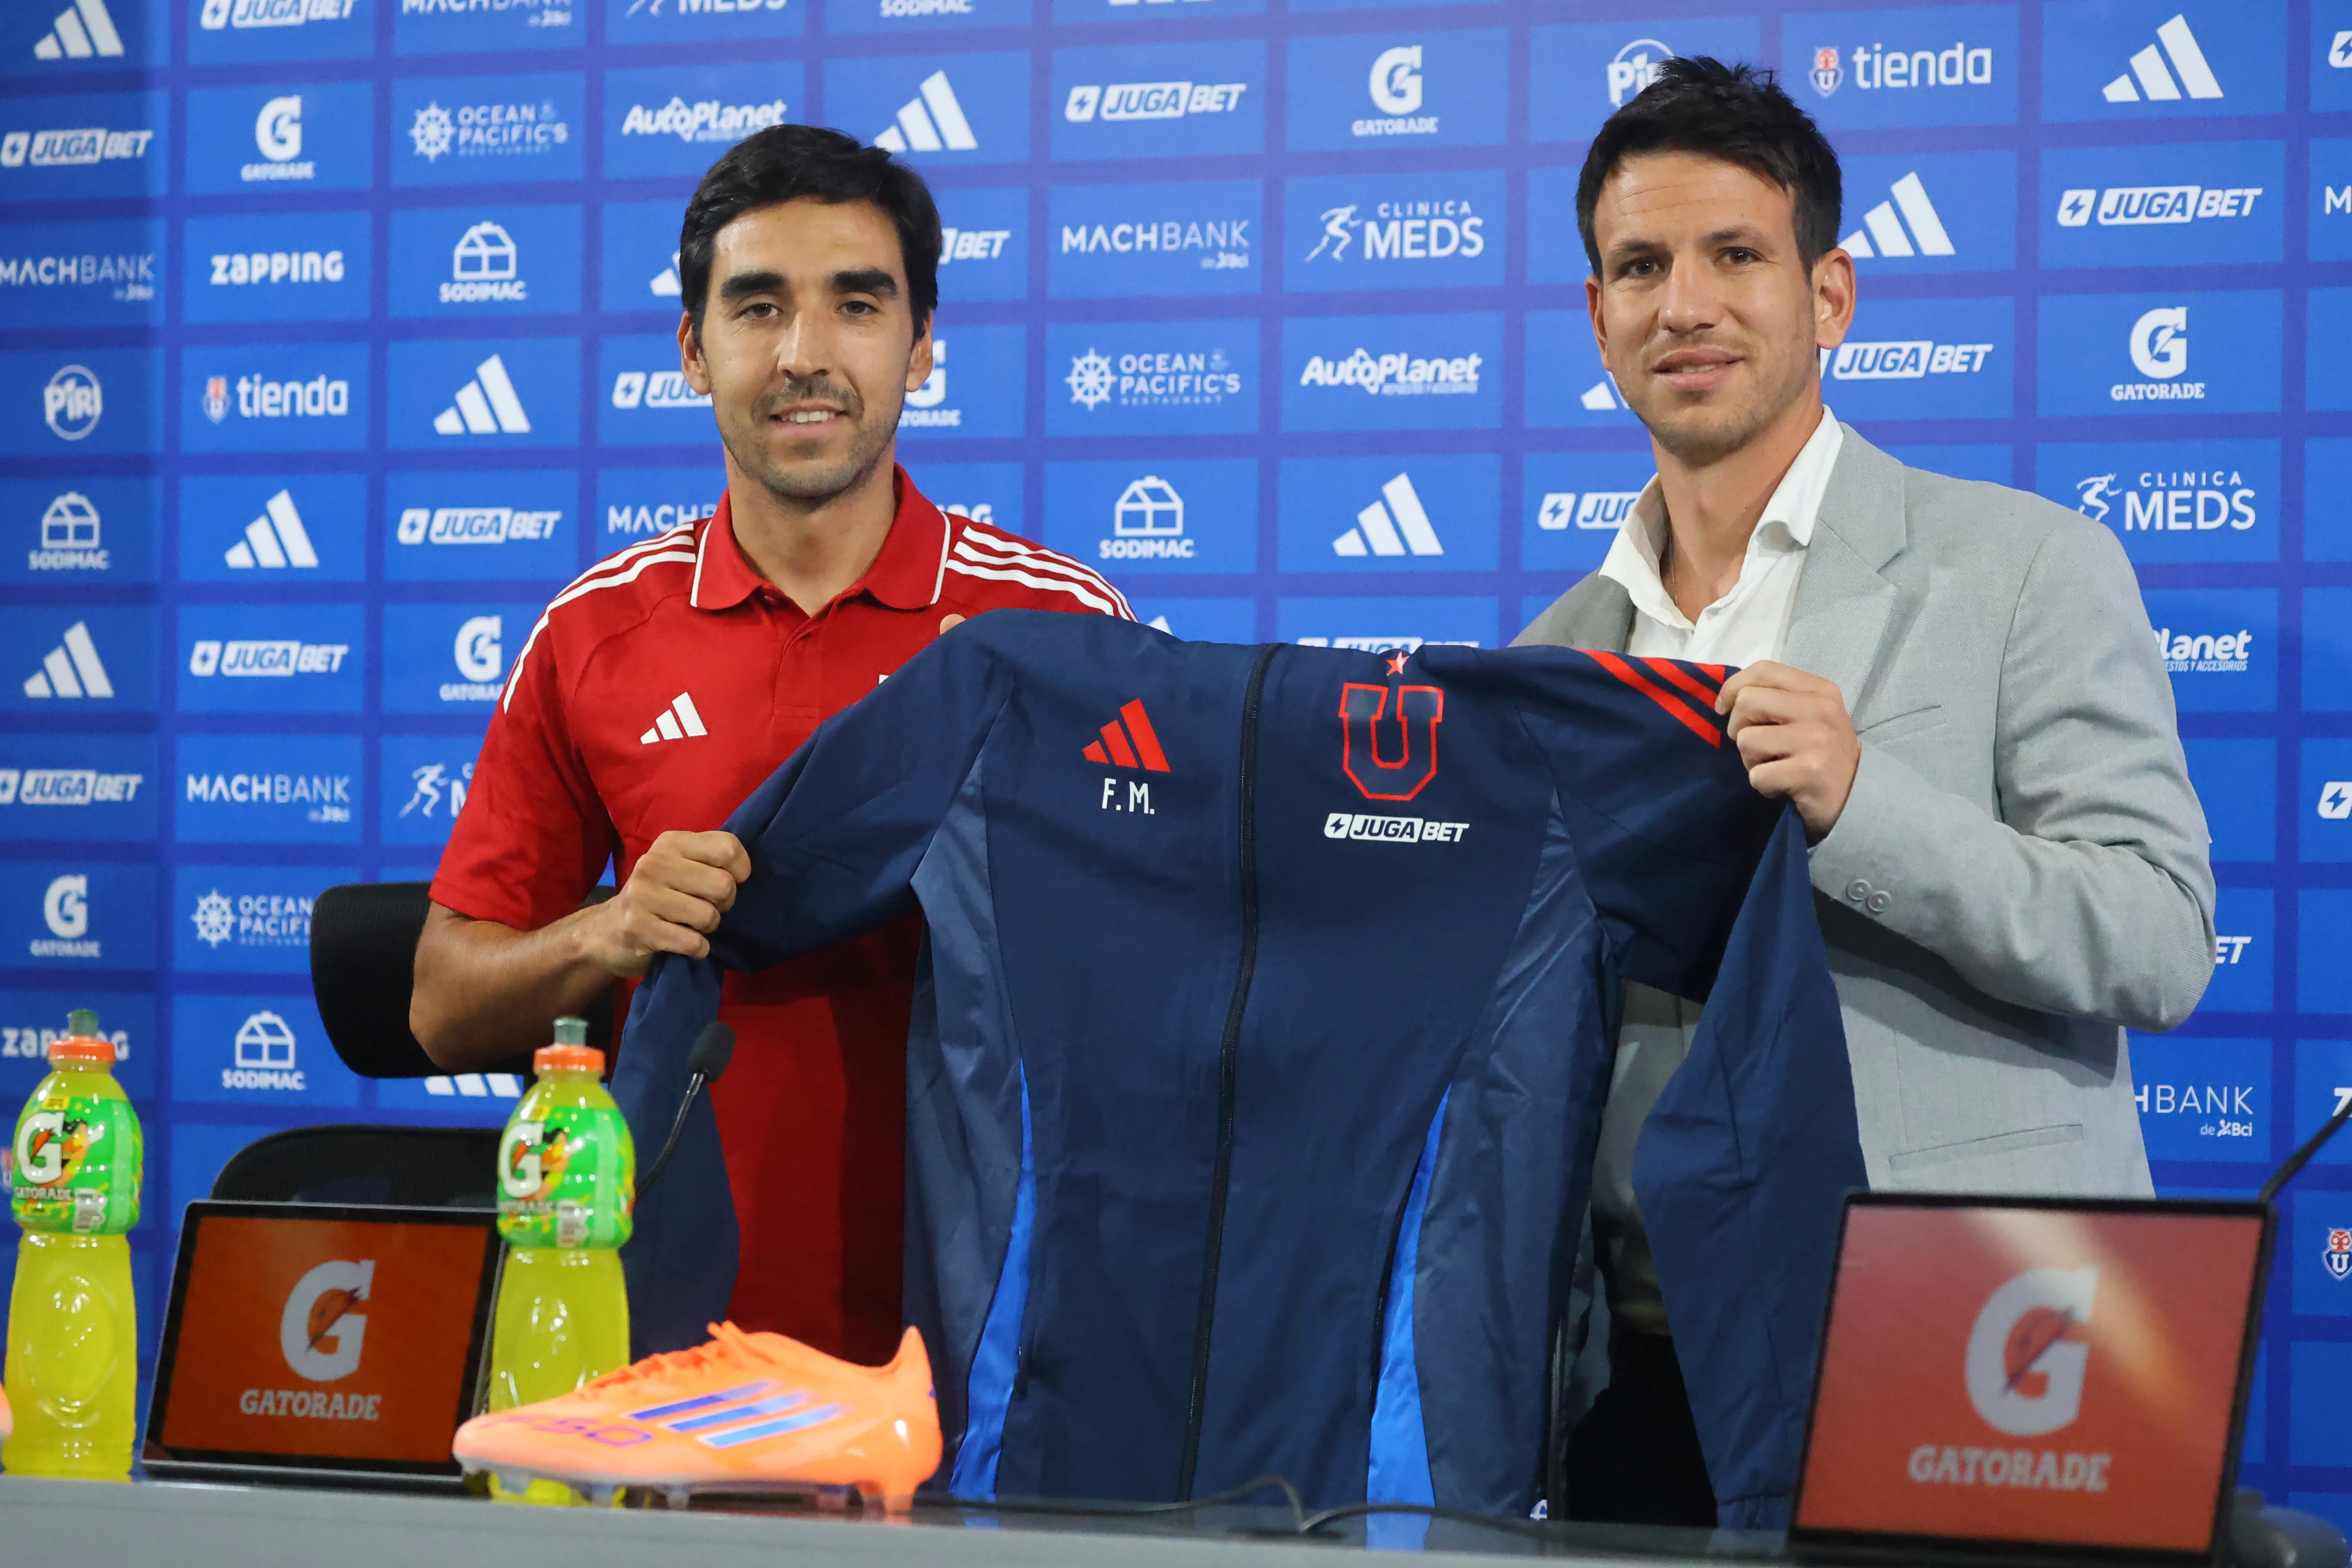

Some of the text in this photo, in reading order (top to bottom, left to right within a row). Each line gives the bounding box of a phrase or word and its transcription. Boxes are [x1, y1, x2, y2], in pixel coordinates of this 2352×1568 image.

[1852, 42, 1992, 89] tienda
[1107, 83, 1247, 114] JUGABET
[458, 105, 536, 125] OCEAN
[622, 97, 787, 142] AutoPlanet
[1352, 117, 1439, 137] GATORADE
[35, 130, 153, 160] JUGABET
[1378, 200, 1476, 219] CLINICA
[2104, 188, 2263, 220] JUGABET
[1365, 217, 1484, 260] MEDS
[440, 281, 526, 303] SODIMAC
[1119, 353, 1205, 374] OCEAN
[1301, 348, 1482, 394] AutoPlanet
[1838, 344, 1994, 374] JUGABET
[237, 374, 348, 417] tienda
[1120, 373, 1241, 395] PACIFIC'S
[2110, 383, 2205, 401] GATORADE
[898, 409, 962, 427] TORADE
[2140, 471, 2242, 487] CLINICA
[608, 504, 718, 533] MACH
[2125, 489, 2255, 531] MEDS
[436, 511, 562, 539] JUGABET
[1099, 539, 1194, 559] SODIMAC
[2154, 628, 2252, 660] lanet
[226, 644, 349, 673] JUGABET
[2196, 660, 2247, 672] ACCESORIOS
[440, 683, 505, 701] GATORA
[1338, 682, 1445, 801] U
[25, 774, 143, 802] JUGABET
[1352, 819, 1470, 842] JUGABET
[239, 895, 314, 916] OCEAN
[240, 916, 311, 936] PACIFI
[222, 1069, 305, 1090] SODIMAC
[2200, 1123, 2215, 1136] de
[240, 1388, 382, 1420] GATORADE
[1908, 1445, 2111, 1492] GATORADE
